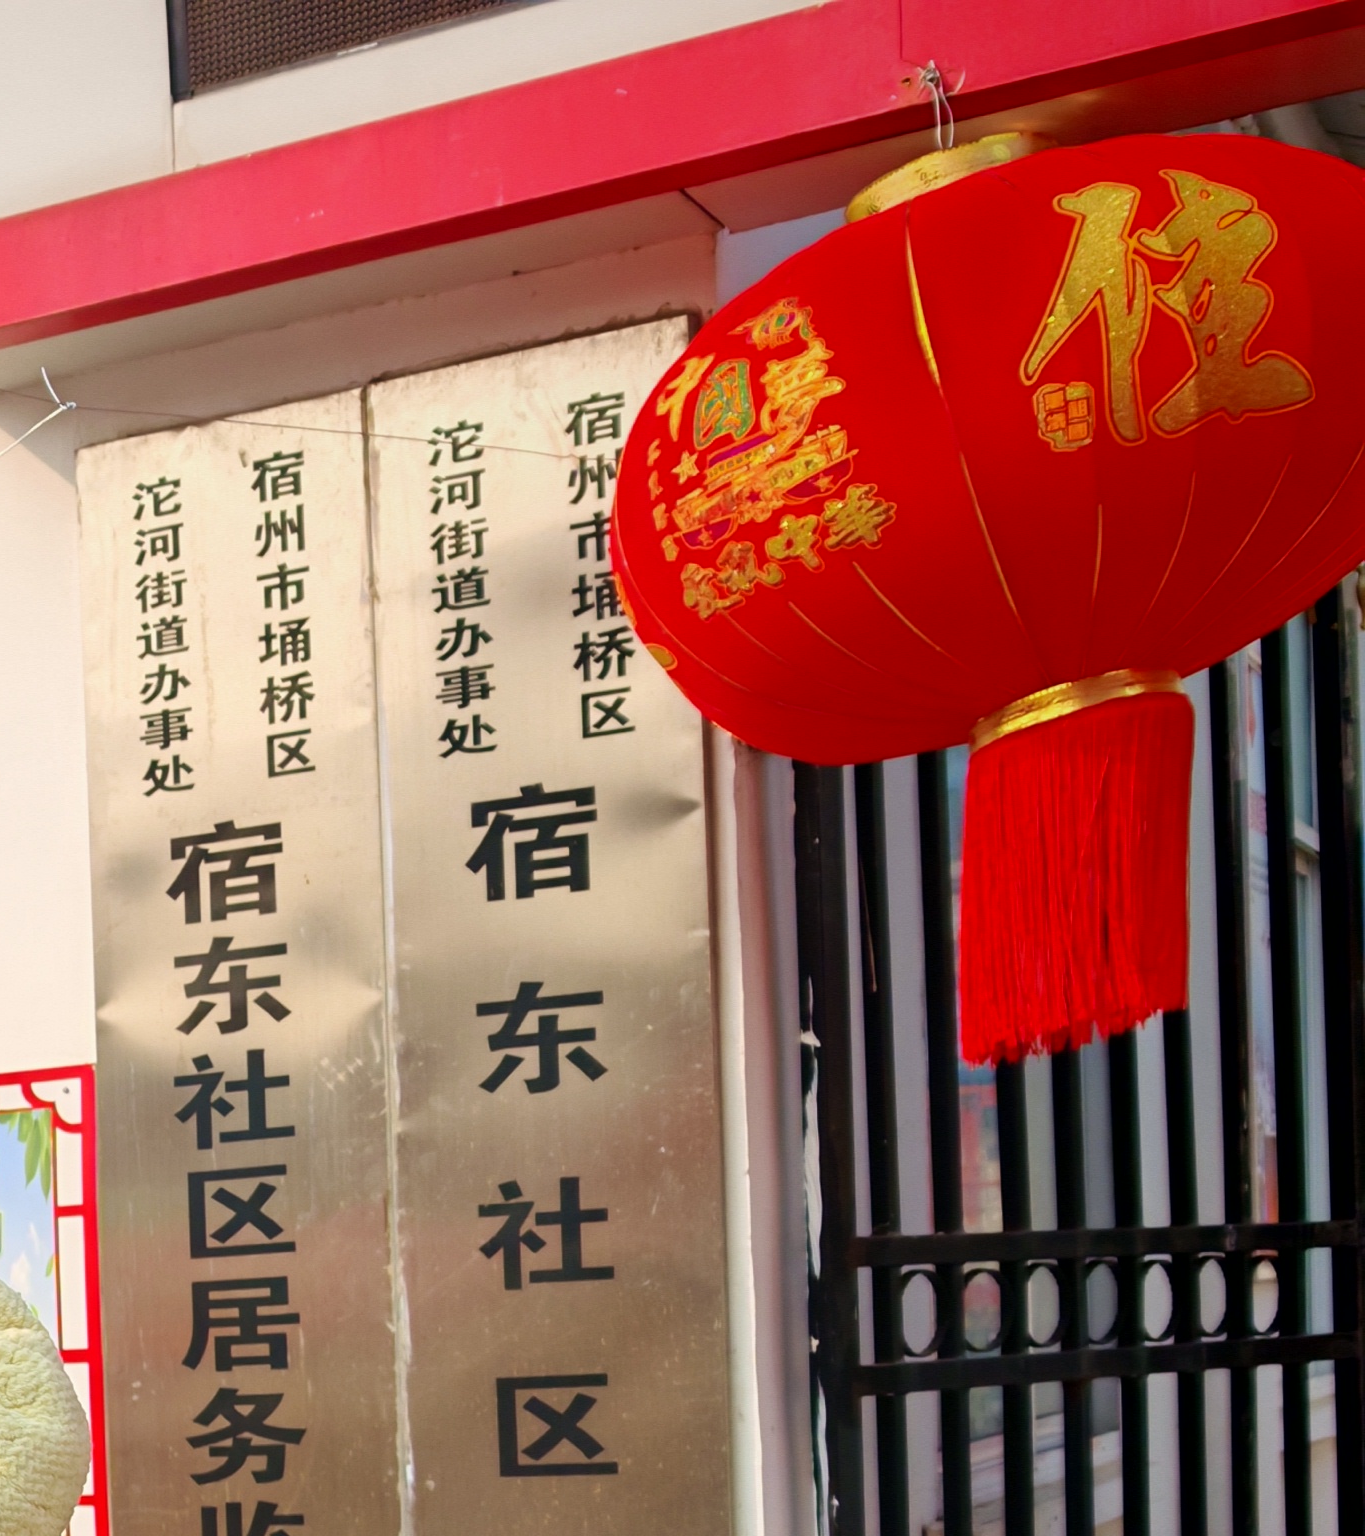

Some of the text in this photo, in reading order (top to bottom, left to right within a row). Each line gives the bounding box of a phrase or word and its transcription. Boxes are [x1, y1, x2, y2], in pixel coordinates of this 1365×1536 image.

[131, 475, 196, 798] 沱河街道办事处
[250, 449, 316, 778] 宿州市埇桥区
[427, 419, 498, 759] 沱河街道办事处
[566, 390, 636, 738] 宿州市埇桥区
